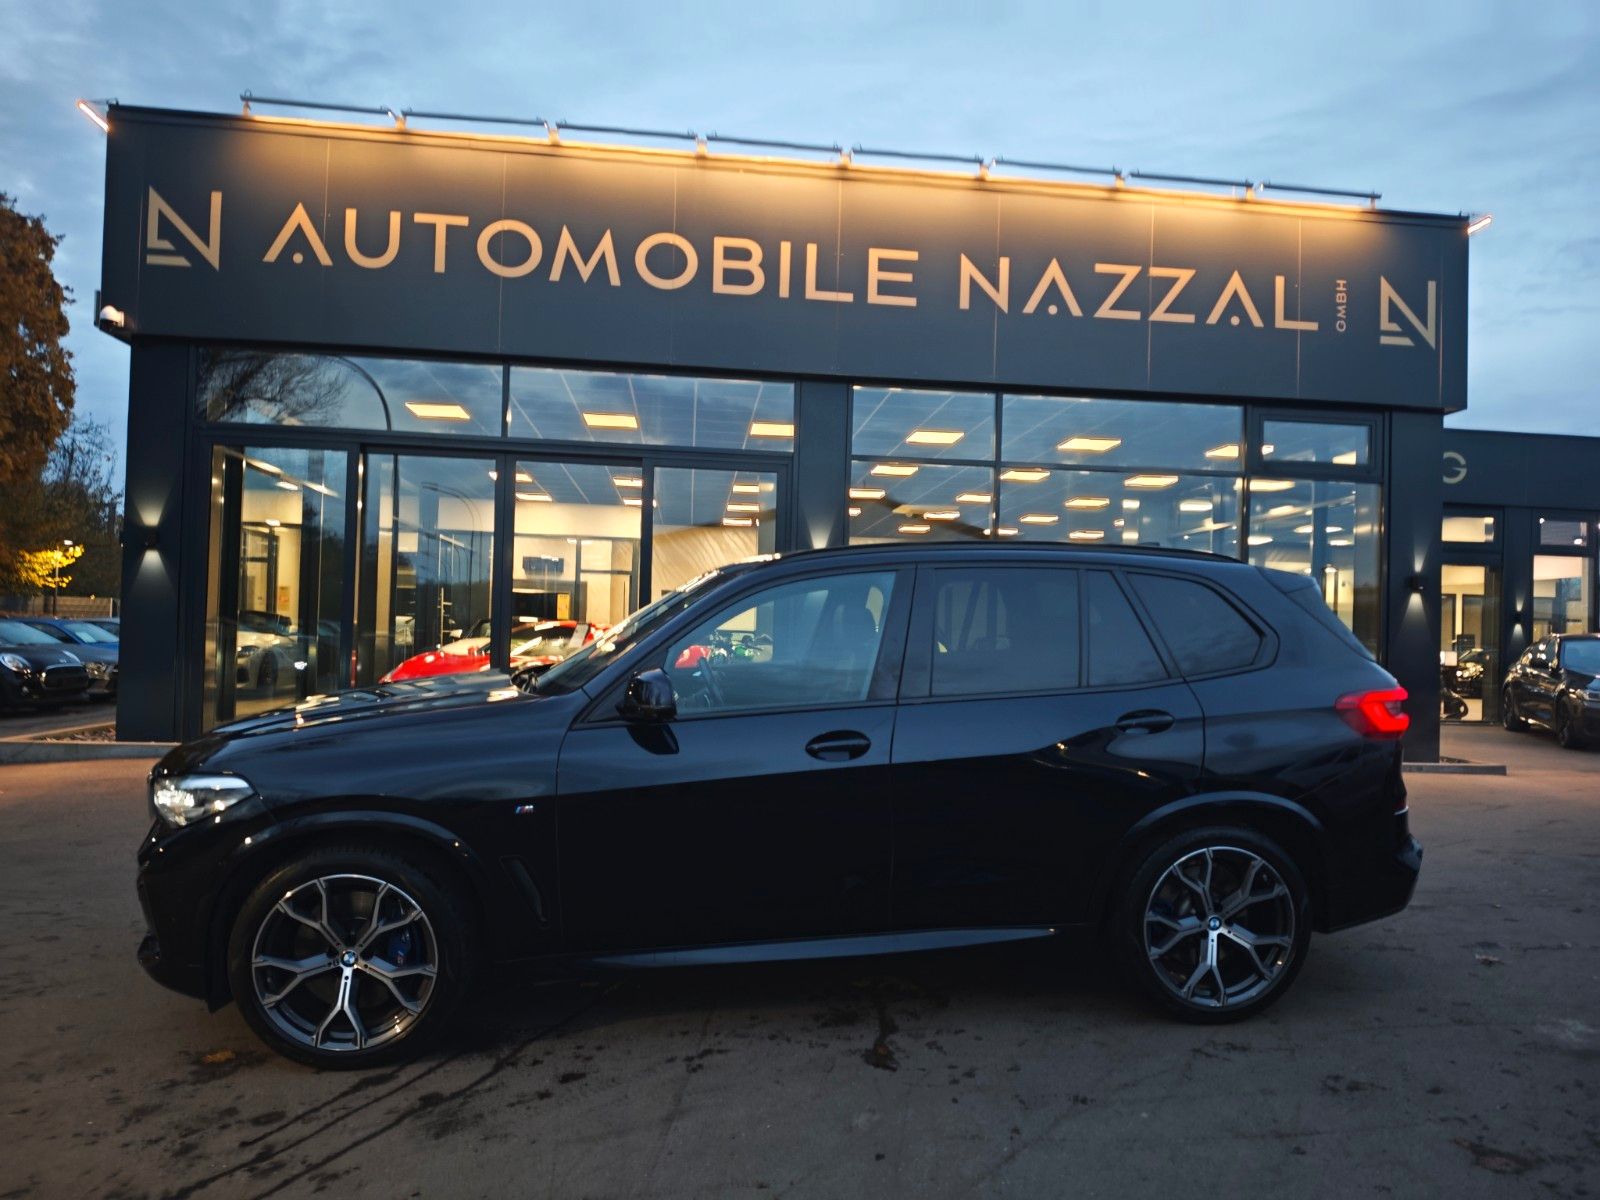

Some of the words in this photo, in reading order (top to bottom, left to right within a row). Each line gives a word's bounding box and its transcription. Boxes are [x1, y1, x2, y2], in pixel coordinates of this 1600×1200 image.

[262, 201, 920, 309] AUTOMOBILE
[958, 252, 1319, 331] NAZZAL
[1335, 279, 1347, 333] GMBH
